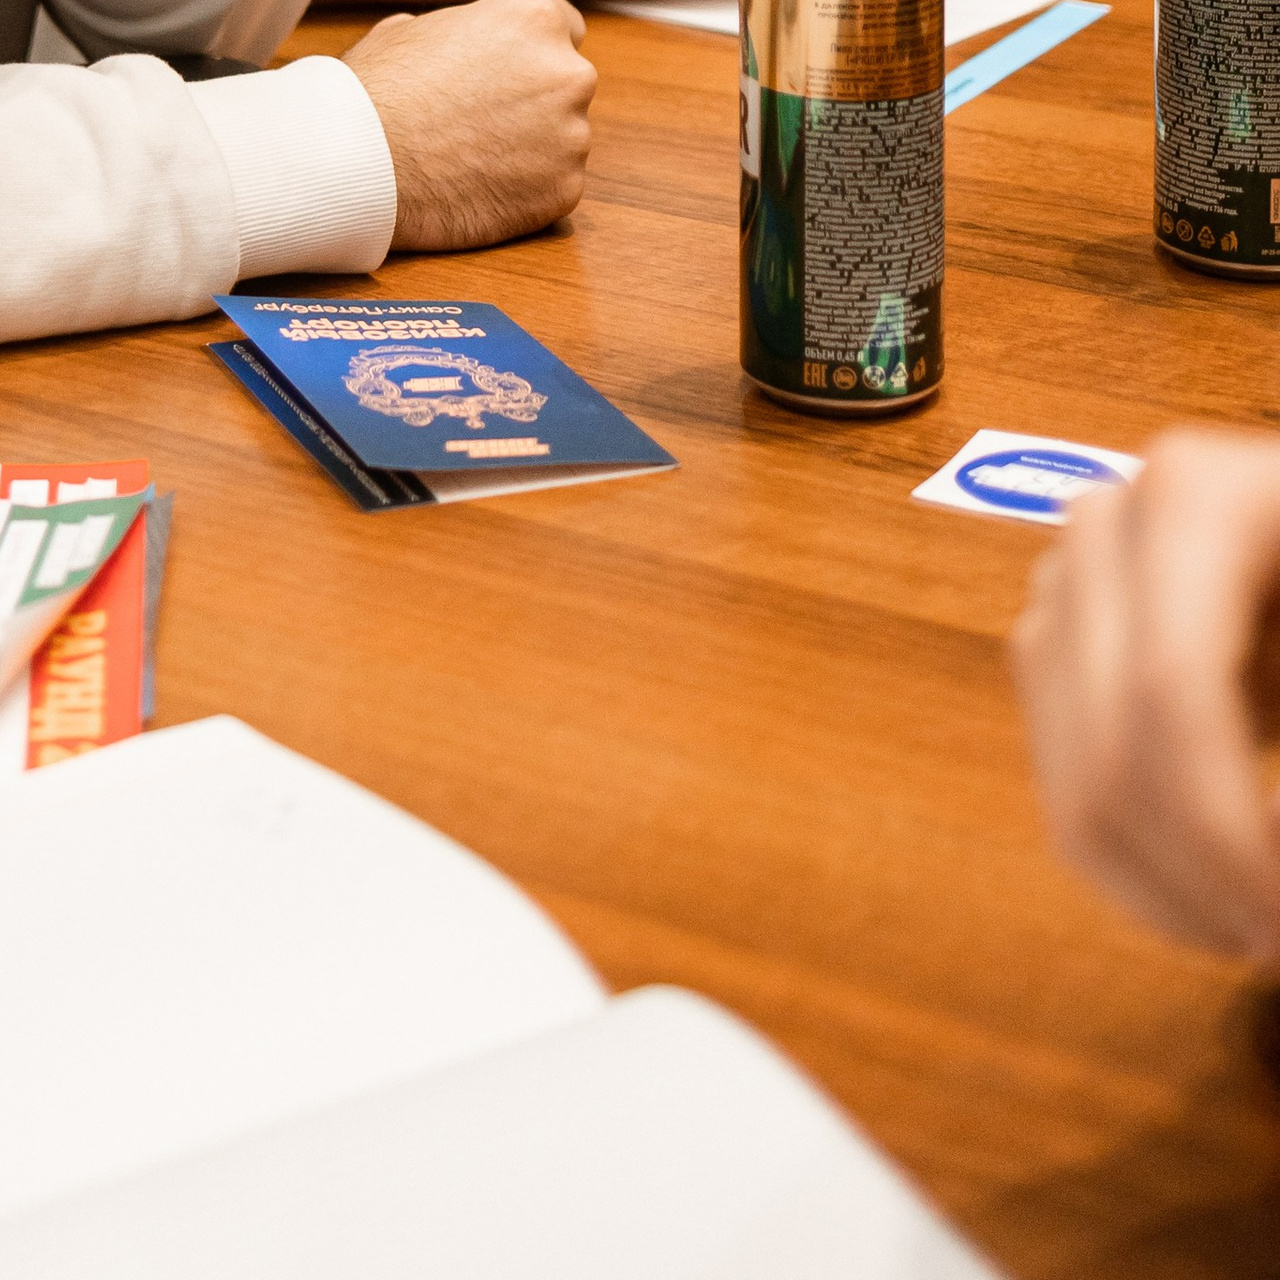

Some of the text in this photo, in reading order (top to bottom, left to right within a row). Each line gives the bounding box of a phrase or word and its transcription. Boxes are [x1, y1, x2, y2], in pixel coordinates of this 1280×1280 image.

[253, 302, 463, 316] Санкт-Петербург
[288, 318, 460, 331] паспорт
[278, 326, 487, 342] квизовый
[30, 609, 107, 740] РАУНД
